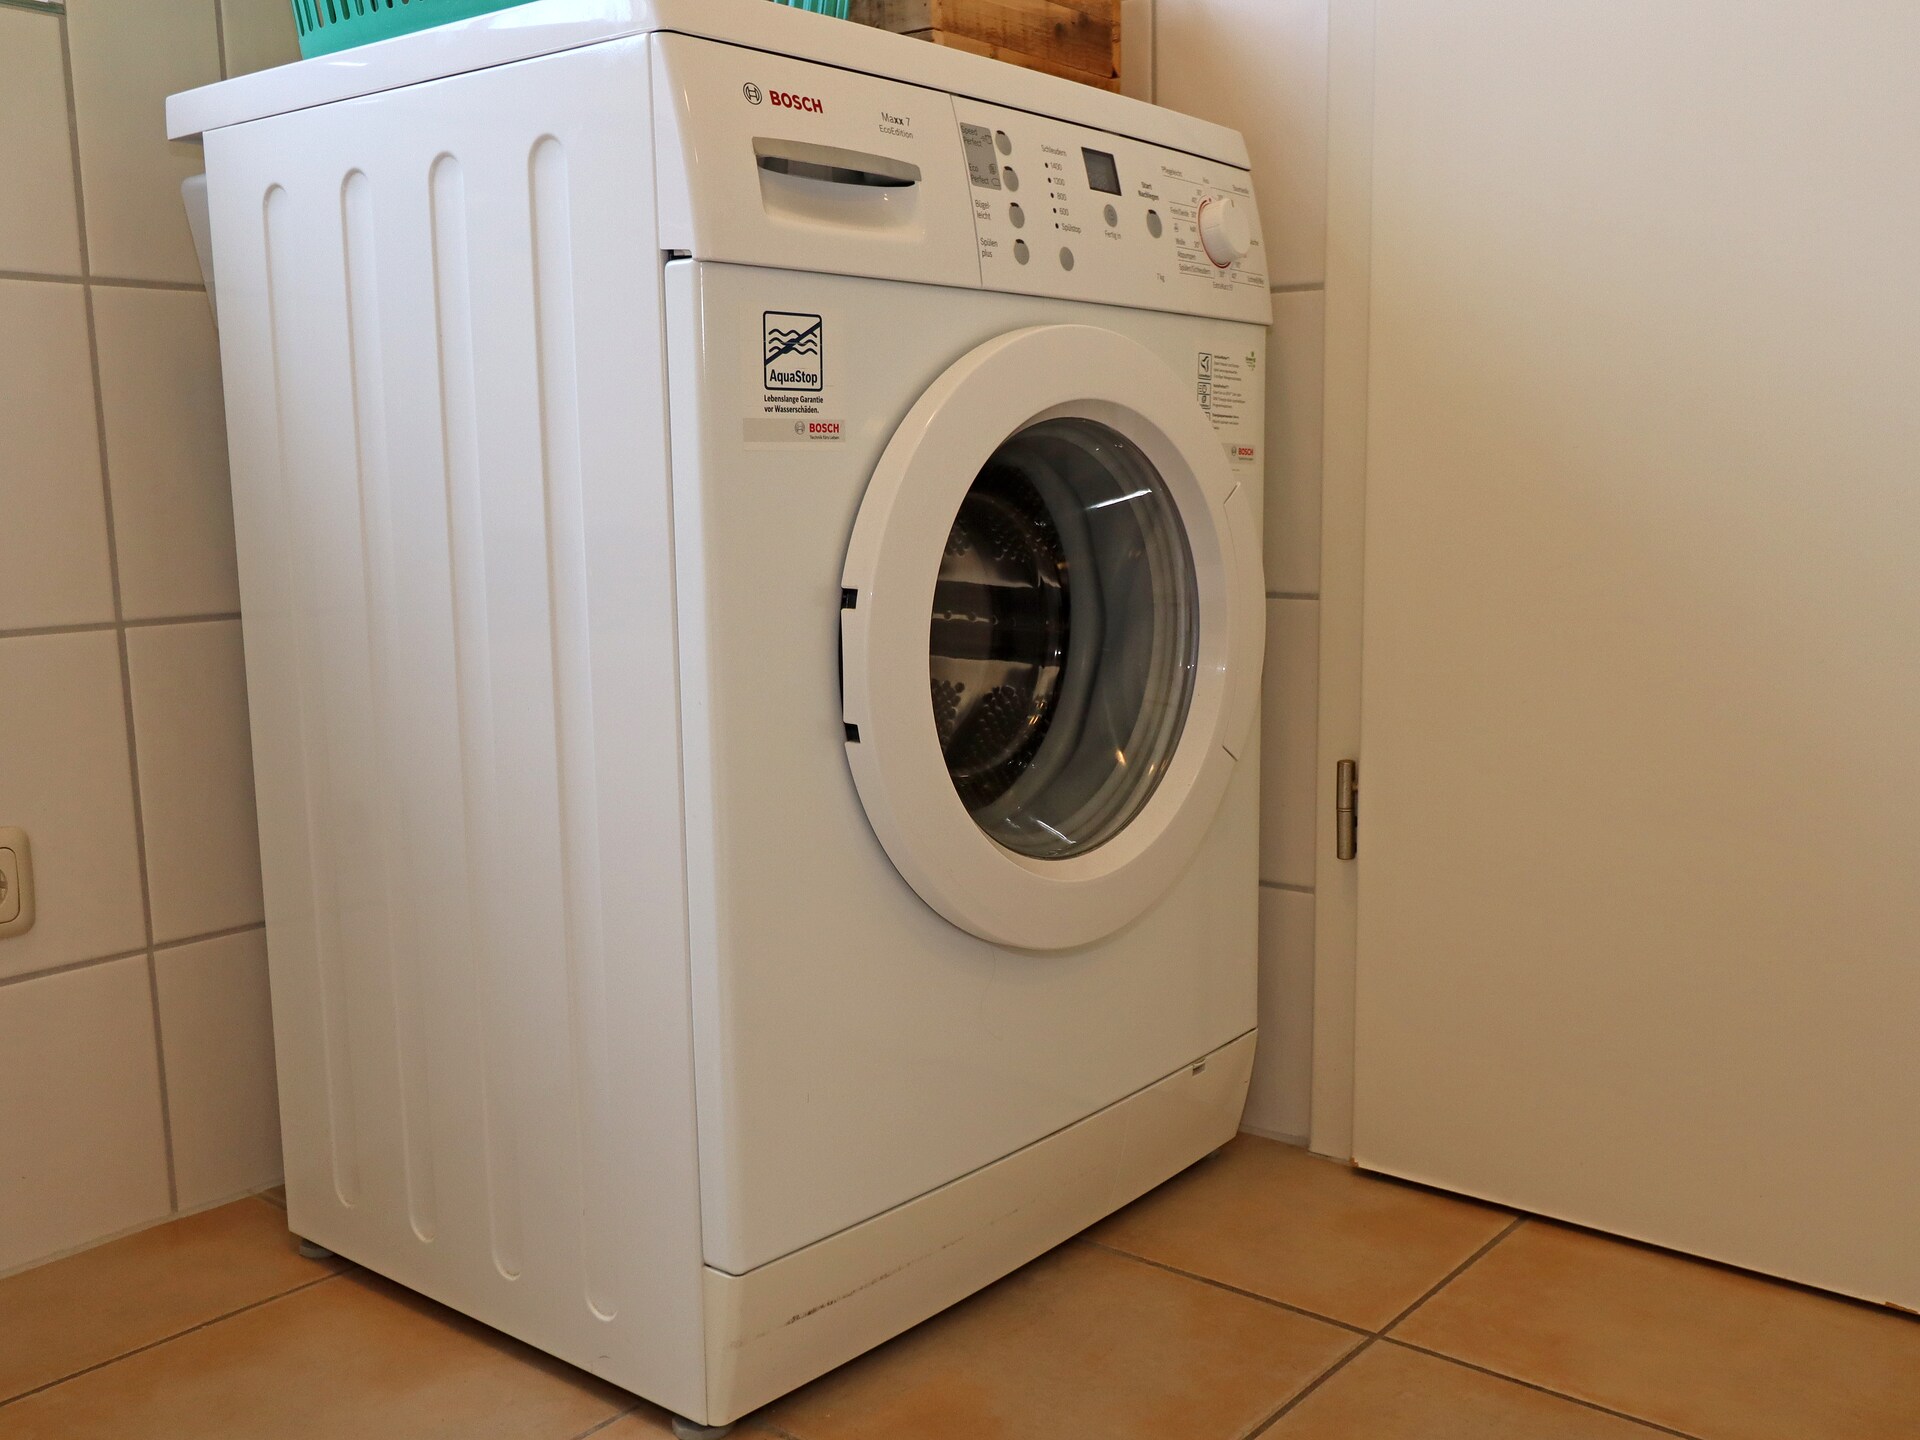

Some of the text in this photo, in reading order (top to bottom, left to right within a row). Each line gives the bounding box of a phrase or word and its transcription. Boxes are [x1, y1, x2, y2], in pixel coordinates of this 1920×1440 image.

[768, 90, 824, 114] BOSCH
[881, 112, 911, 127] Maxx 7
[878, 124, 914, 139] EcoEdition
[963, 136, 982, 147] Perfect
[969, 163, 979, 172] Eco
[970, 174, 990, 185] Perfect
[975, 199, 990, 210] Bügel-
[976, 210, 991, 221] leicht
[980, 237, 998, 248] Spülen
[982, 248, 993, 258] plus
[769, 369, 818, 386] AquaStop
[763, 394, 824, 405] Lebenslange Garantie
[764, 405, 820, 414] vor Wasserschäden.
[809, 423, 840, 433] BOSCH
[1238, 447, 1254, 456] BOSCH
